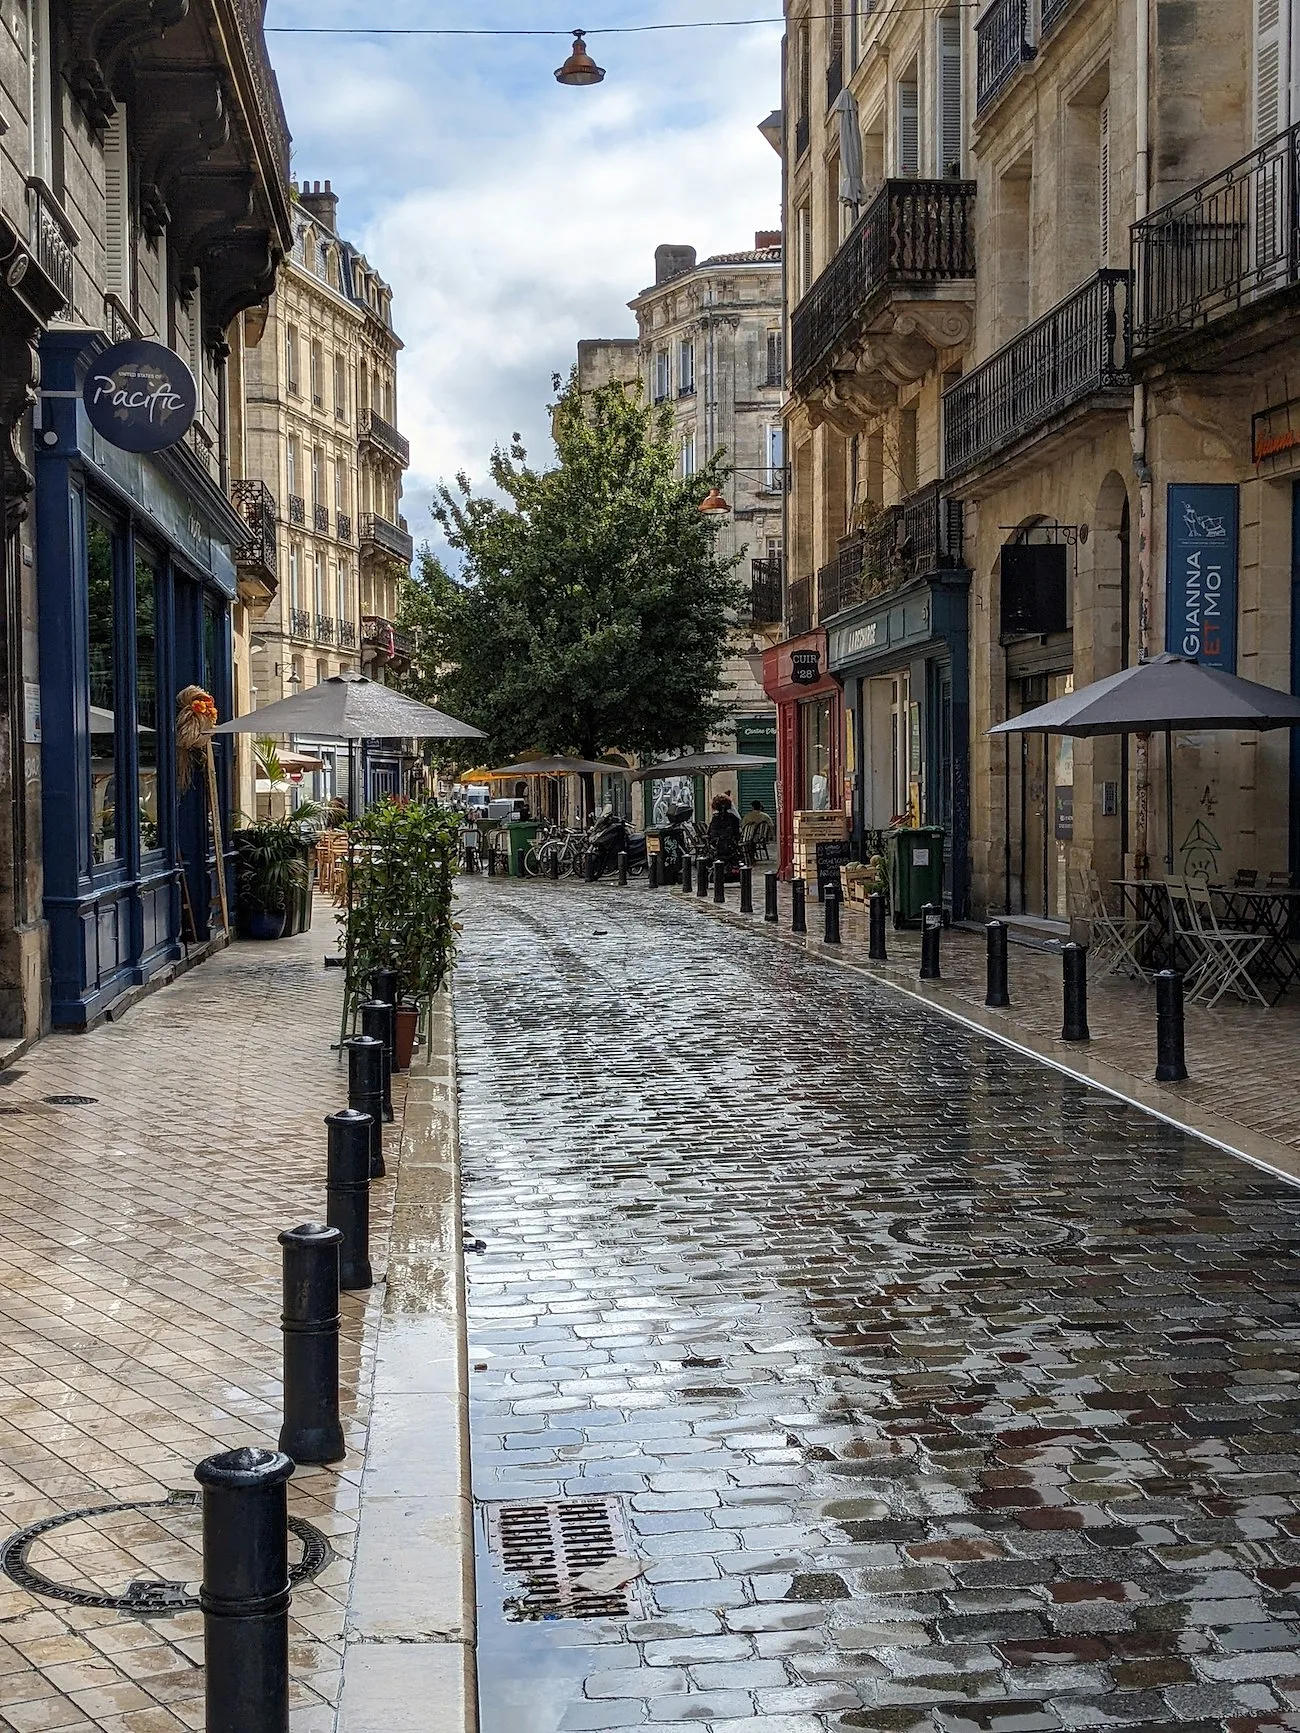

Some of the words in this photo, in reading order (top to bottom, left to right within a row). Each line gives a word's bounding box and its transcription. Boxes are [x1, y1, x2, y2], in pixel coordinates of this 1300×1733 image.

[93, 375, 185, 423] Pacific
[1182, 550, 1201, 656] GIANNA
[1203, 565, 1222, 616] MOI
[792, 654, 818, 664] CUIR
[1203, 620, 1220, 656] ET
